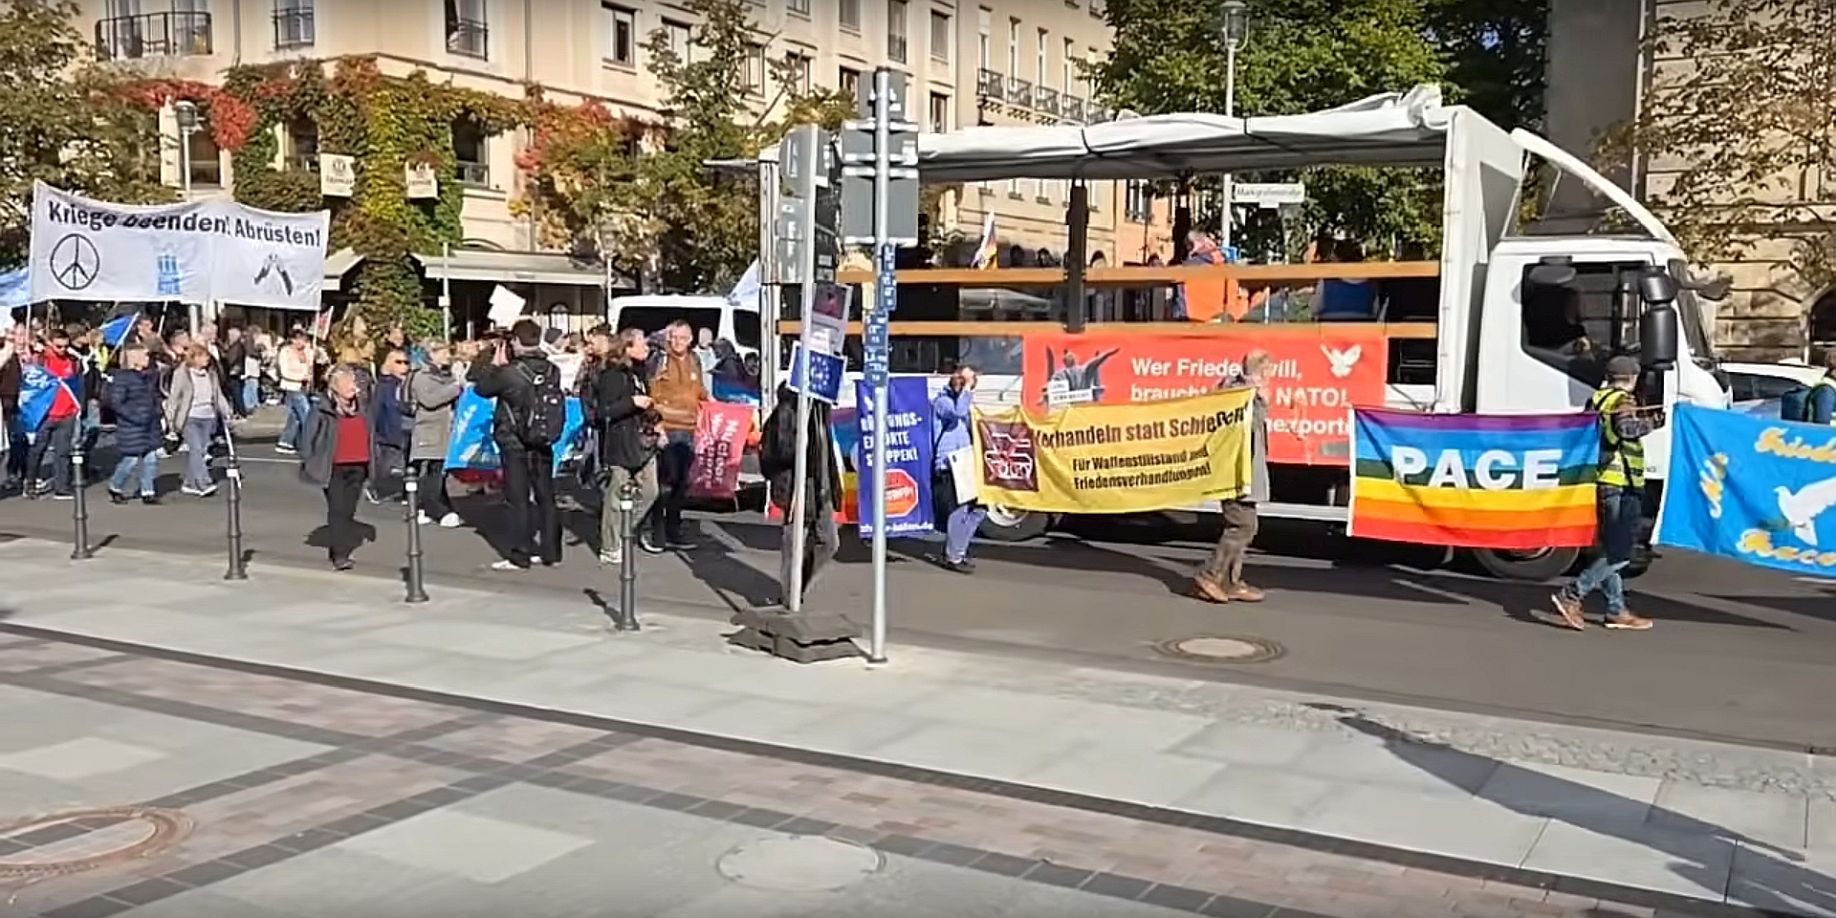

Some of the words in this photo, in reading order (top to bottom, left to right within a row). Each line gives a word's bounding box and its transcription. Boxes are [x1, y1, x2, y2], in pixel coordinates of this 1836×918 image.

[49, 202, 116, 231] Kriege
[235, 217, 321, 247] Abrüsten!
[1131, 357, 1172, 377] Wer
[1177, 357, 1246, 377] Friede
[1276, 387, 1349, 408] NATO!
[860, 411, 922, 432] RÜUNGS-
[1126, 420, 1165, 441] statt
[863, 431, 910, 450] EXRTE
[866, 447, 918, 467] SPPEN!
[1073, 457, 1091, 472] Für
[1092, 449, 1187, 471] Waffenstillstand
[1391, 444, 1563, 490] PACE
[1074, 462, 1212, 489] Friedensverhandlungen!
